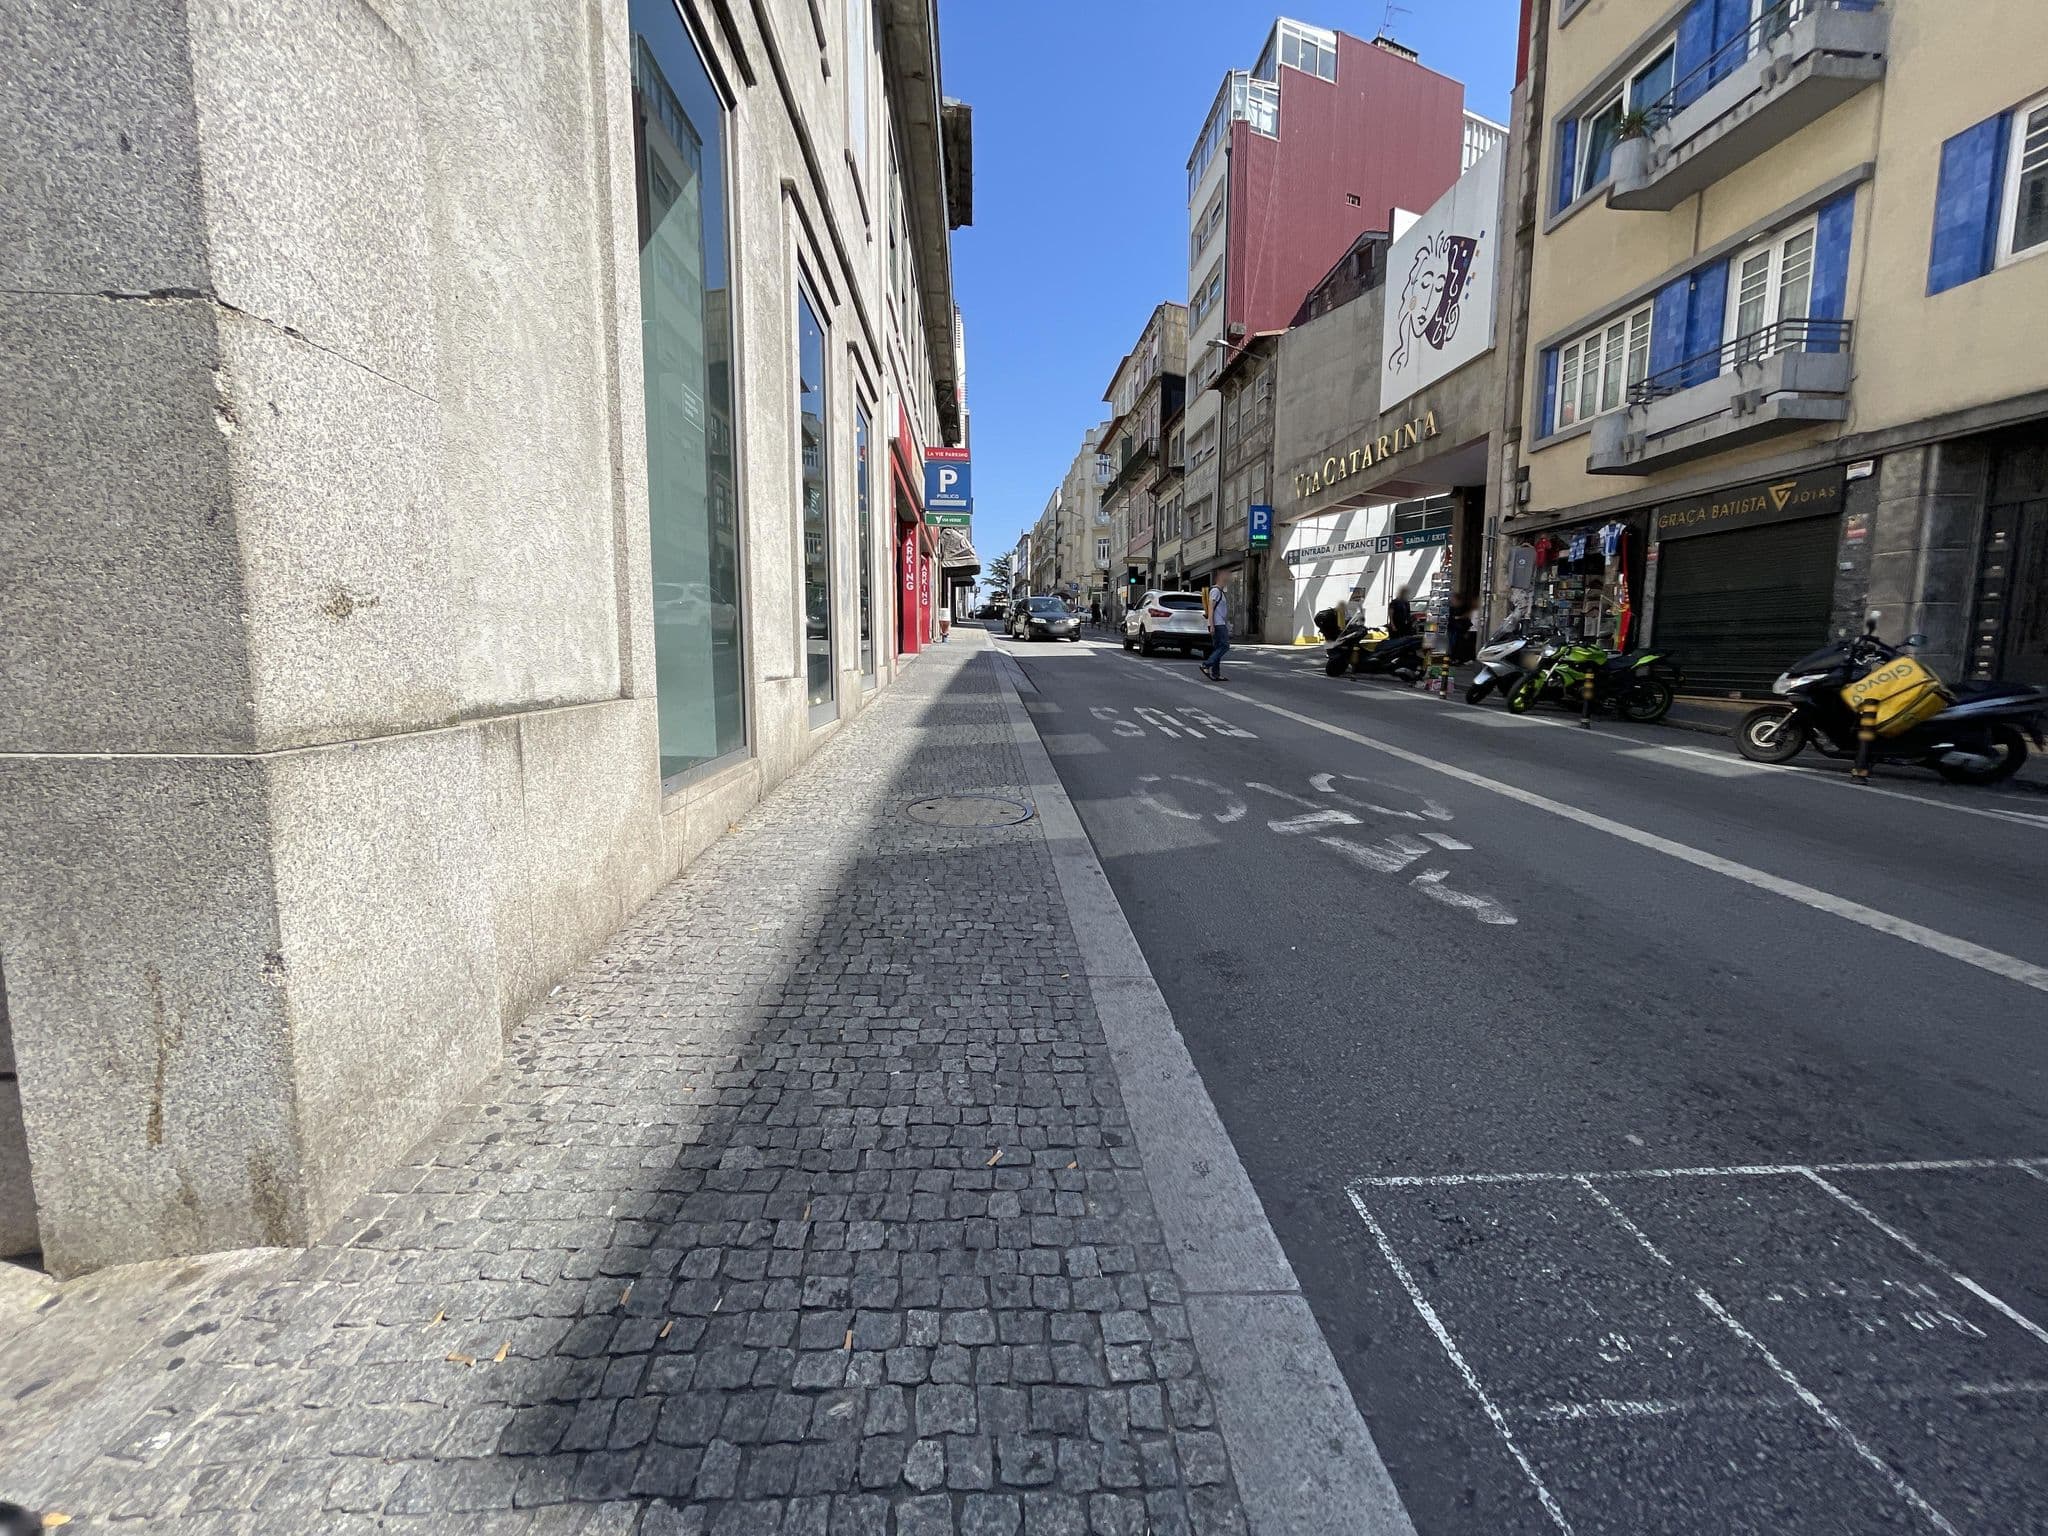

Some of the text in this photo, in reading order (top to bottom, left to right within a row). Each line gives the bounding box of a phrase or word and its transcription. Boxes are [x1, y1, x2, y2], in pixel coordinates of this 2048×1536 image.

[1323, 410, 1441, 486] CATARINA
[939, 469, 958, 493] P
[1712, 495, 1768, 519] BATISTA
[1253, 511, 1268, 530] P
[1301, 544, 1331, 557] ENTRADA
[1338, 539, 1375, 552] ENTRANCE
[1380, 539, 1388, 550] P
[1431, 532, 1446, 541] EXIT
[905, 528, 914, 591] PARKING
[1853, 663, 1914, 693] Glovo
